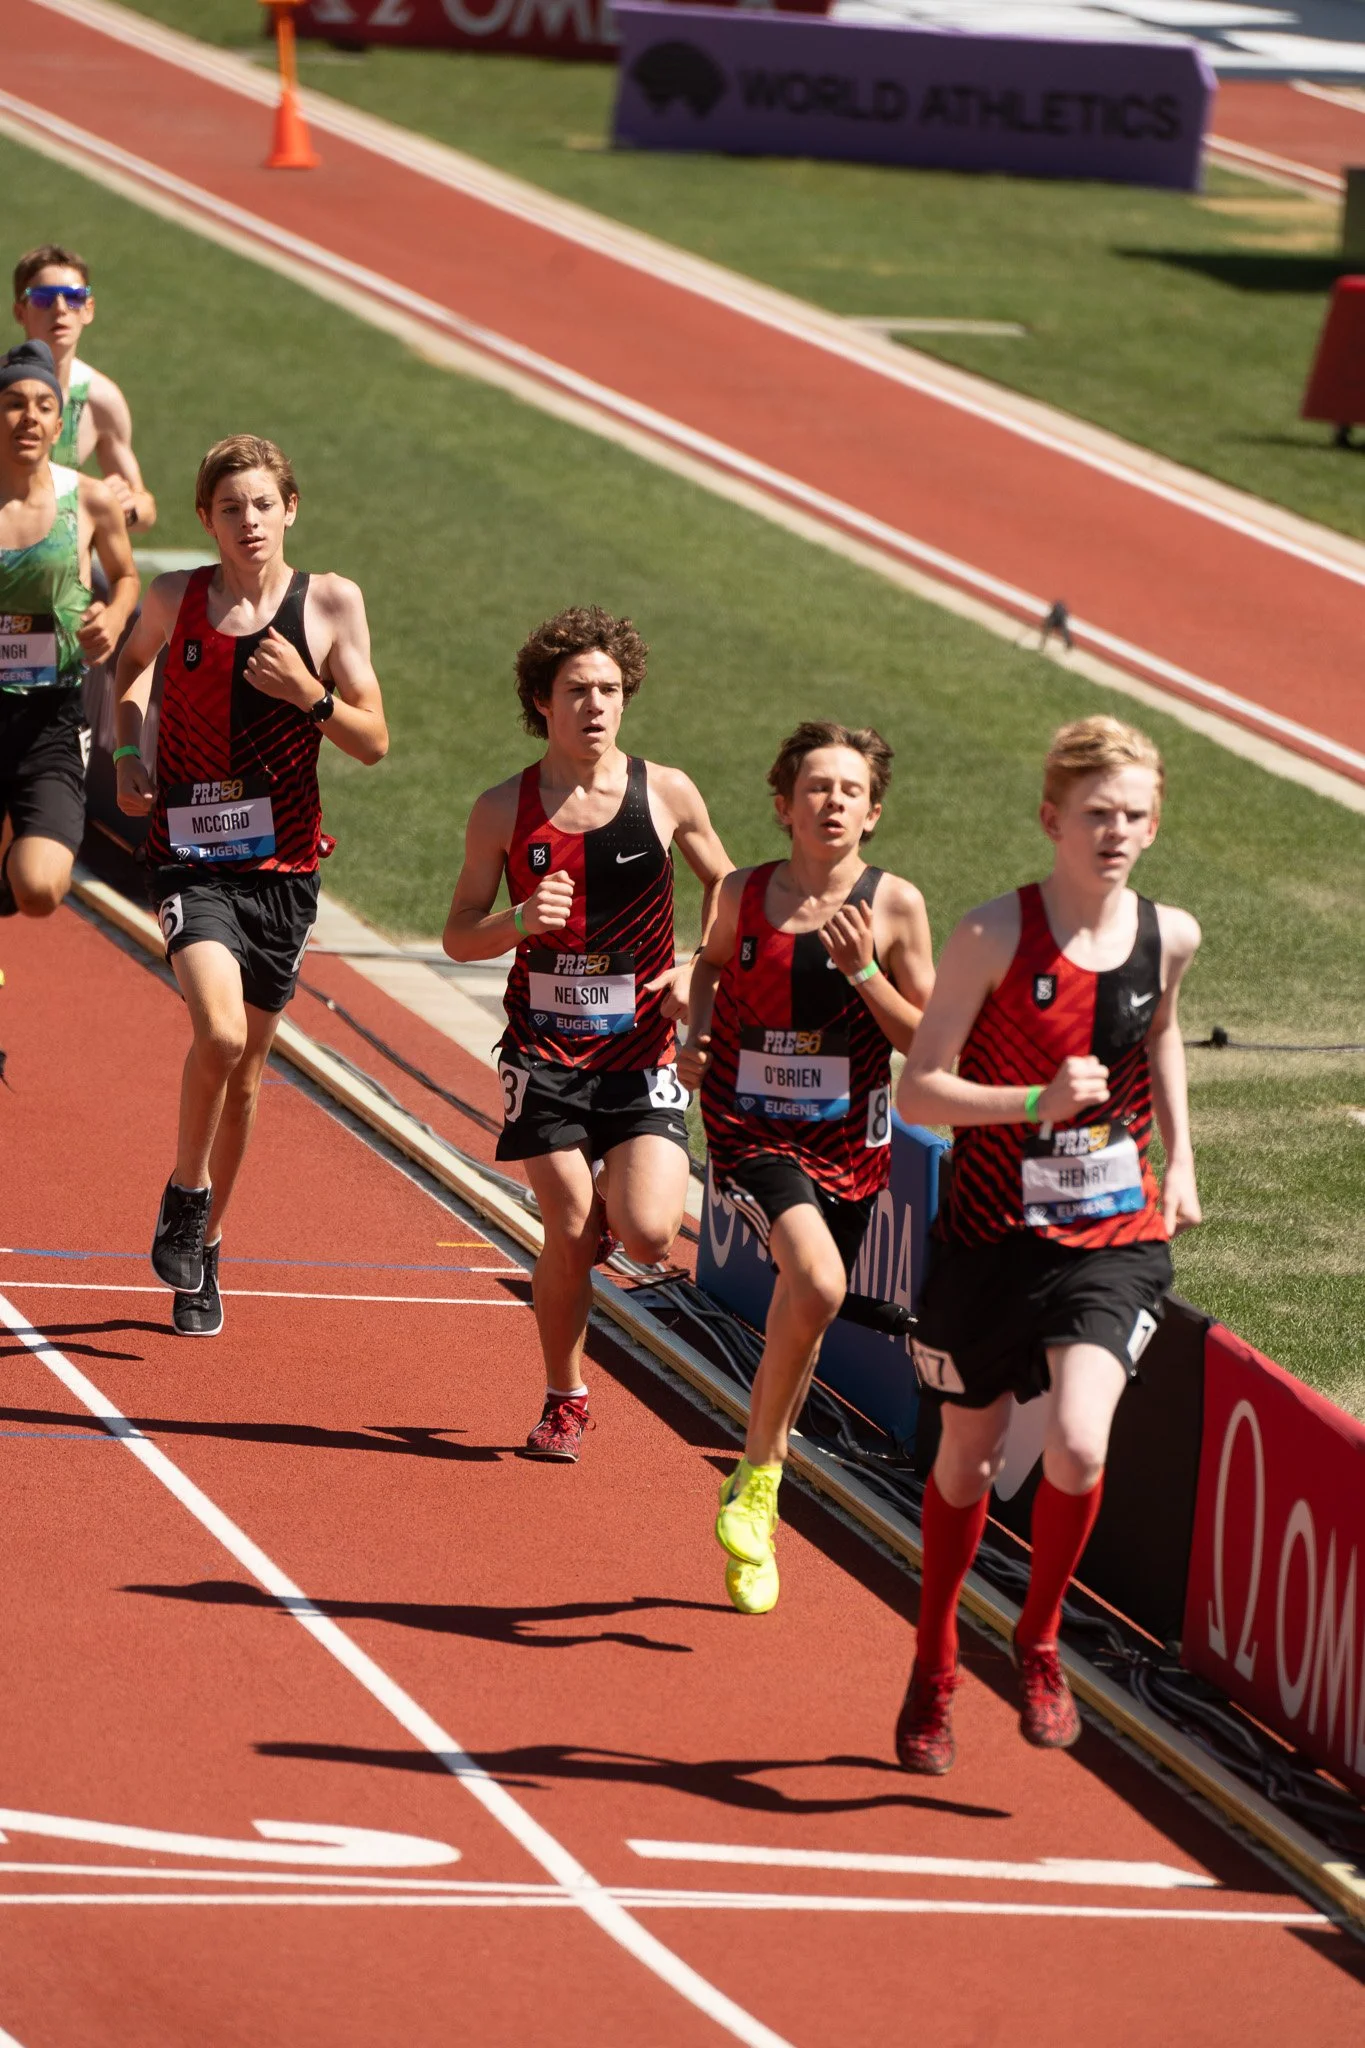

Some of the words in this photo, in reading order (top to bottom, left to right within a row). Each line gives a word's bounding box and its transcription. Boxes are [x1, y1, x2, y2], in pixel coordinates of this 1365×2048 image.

[740, 71, 906, 123] WORLD
[919, 84, 1181, 141] ATHLETICS
[192, 811, 250, 835] MCCORD
[199, 843, 251, 859] EUGENE
[554, 954, 610, 975] PRE50
[554, 986, 609, 1005] NELSON
[556, 1017, 608, 1031] EUGENE
[764, 1065, 822, 1088] O'BRIEN
[502, 1069, 518, 1115] 3
[764, 1101, 820, 1116] EUGENE
[872, 1092, 888, 1141] 8
[1058, 1162, 1109, 1188] HENRY
[1055, 1197, 1114, 1218] EUGENE
